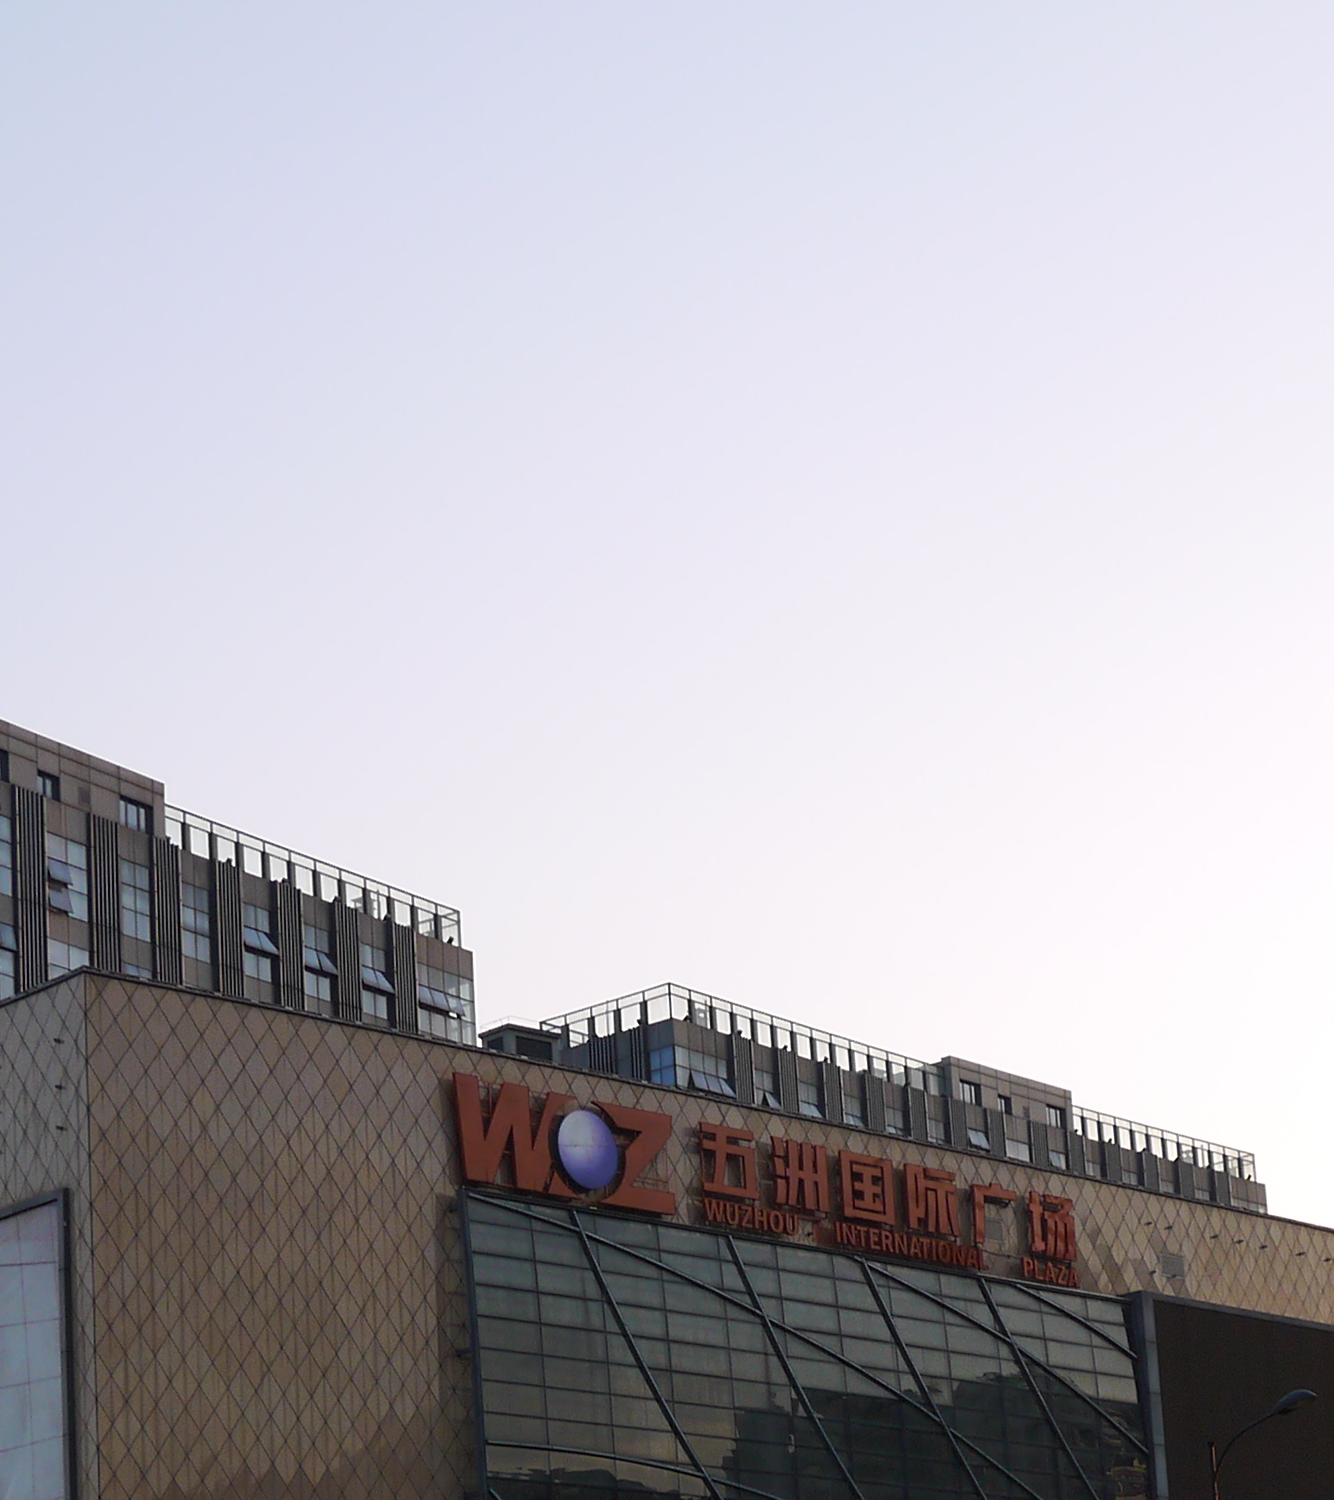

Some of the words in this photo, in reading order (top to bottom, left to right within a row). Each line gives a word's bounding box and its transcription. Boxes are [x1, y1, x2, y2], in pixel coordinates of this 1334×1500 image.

[698, 1121, 1078, 1263] 五洲国际广场
[703, 1197, 801, 1237] WUZHOU
[833, 1220, 990, 1273] INTERNATIONAL
[1021, 1255, 1082, 1289] PLAZA
